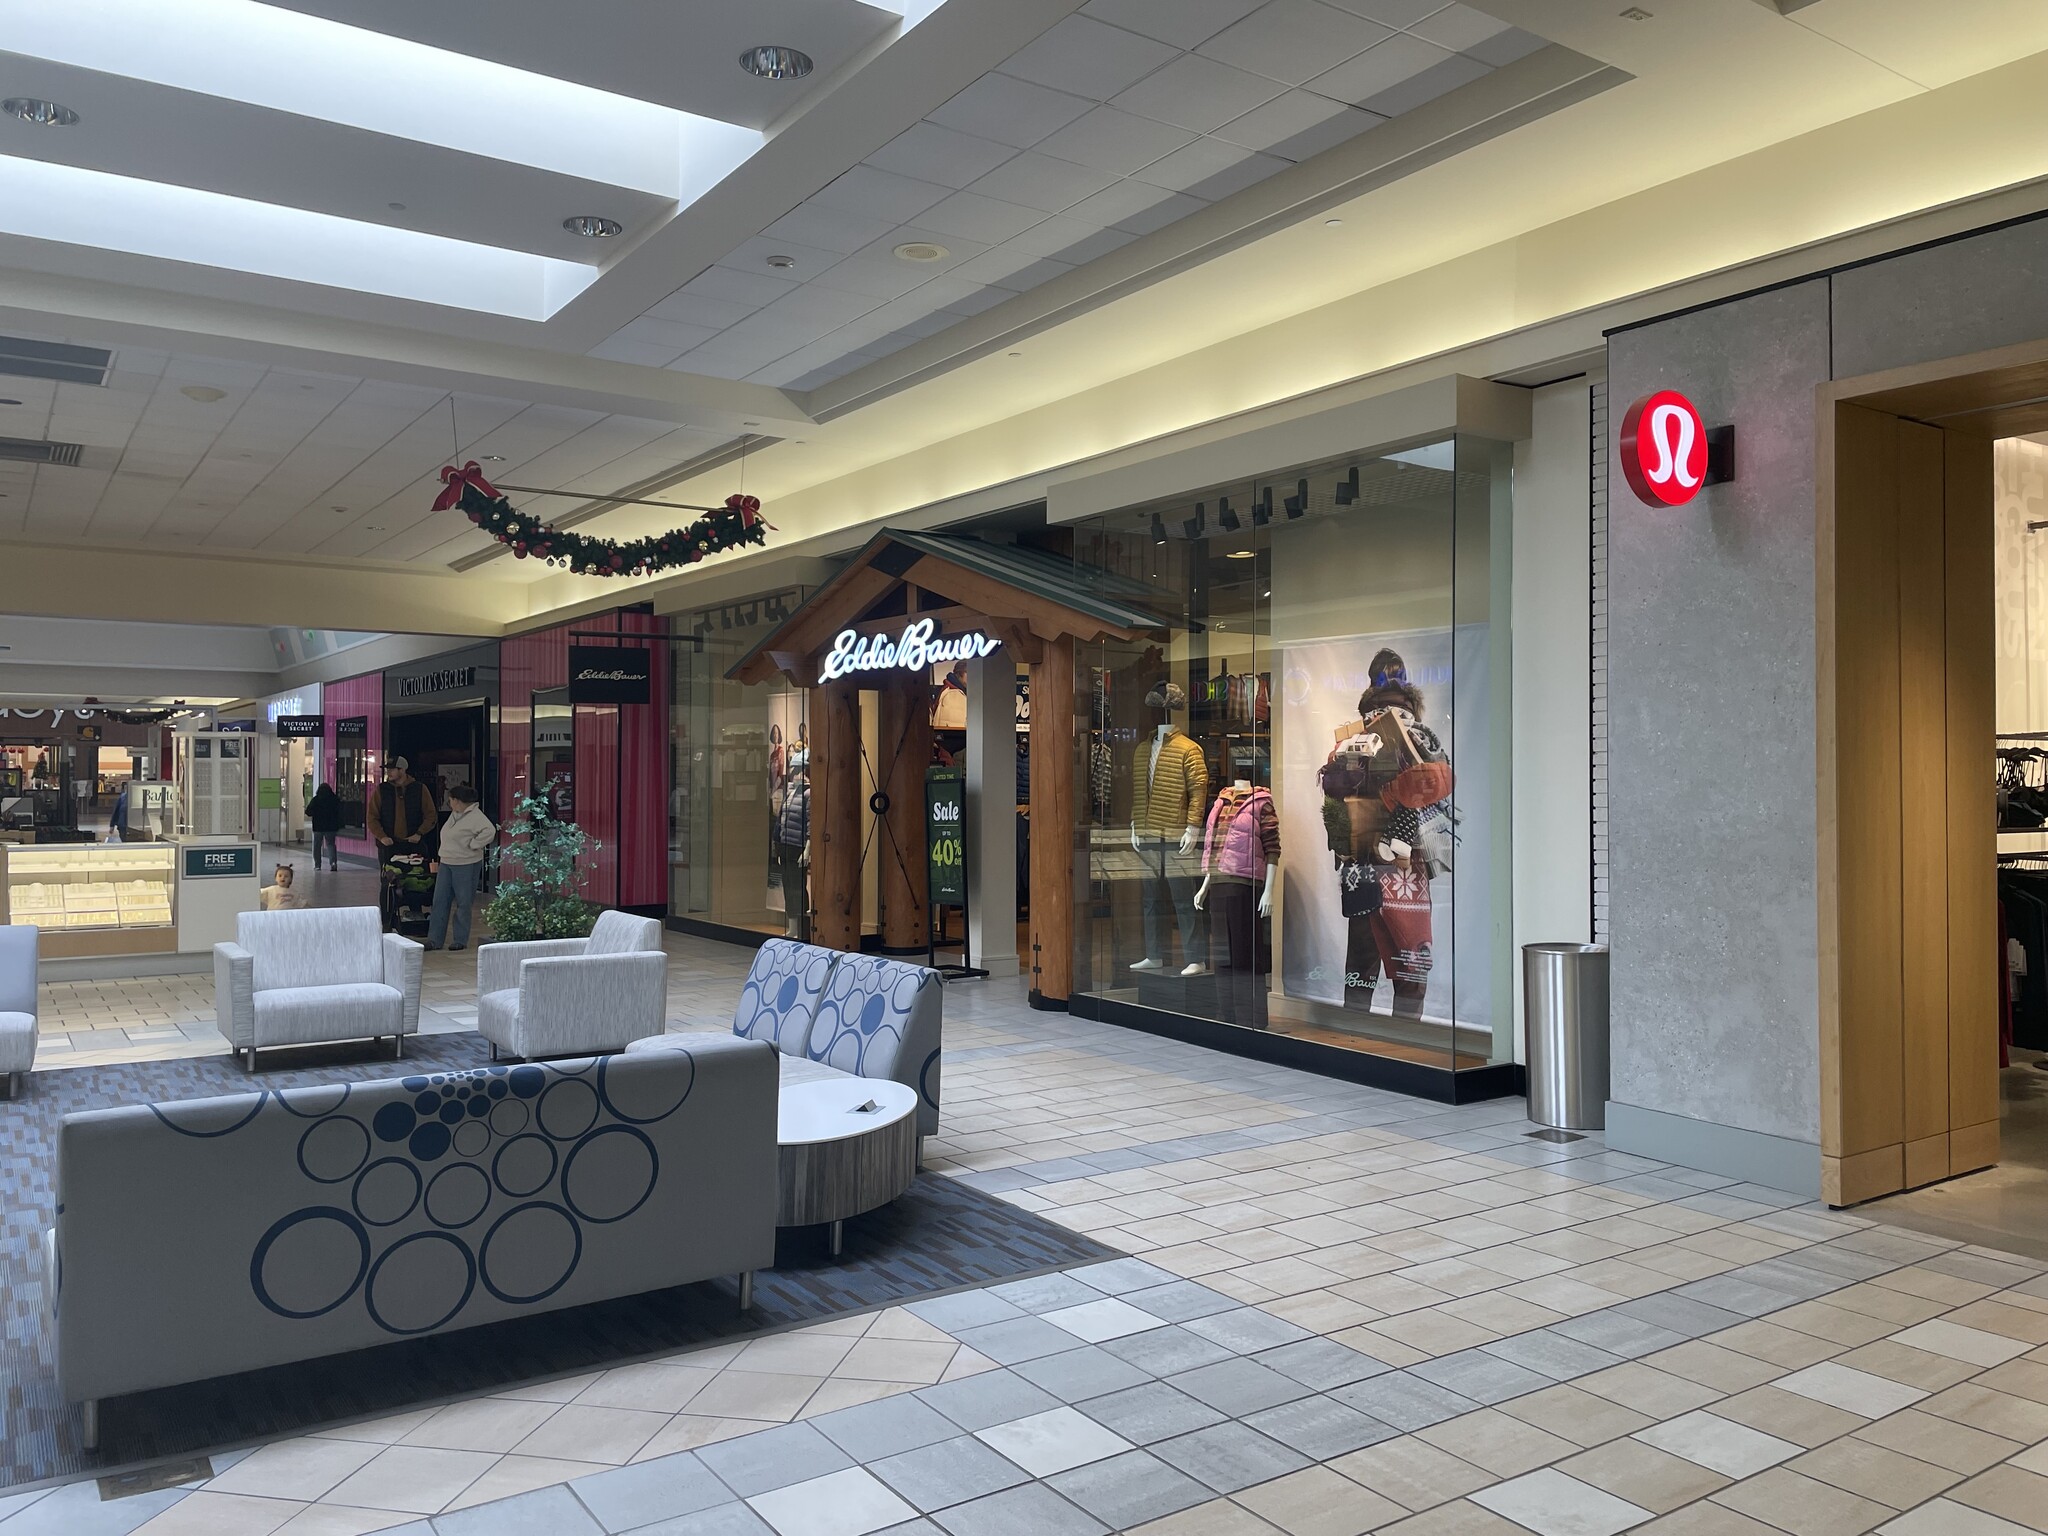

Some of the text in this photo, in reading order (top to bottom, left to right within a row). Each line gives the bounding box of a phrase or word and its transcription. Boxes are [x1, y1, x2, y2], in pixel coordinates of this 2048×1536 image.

[817, 617, 1000, 685] Eddie Bauer
[397, 666, 470, 697] VICTORIA'S SECRET
[575, 669, 647, 681] Eddie Bauer
[933, 800, 959, 821] Sale
[204, 853, 236, 864] FREE
[932, 839, 962, 867] 40%
